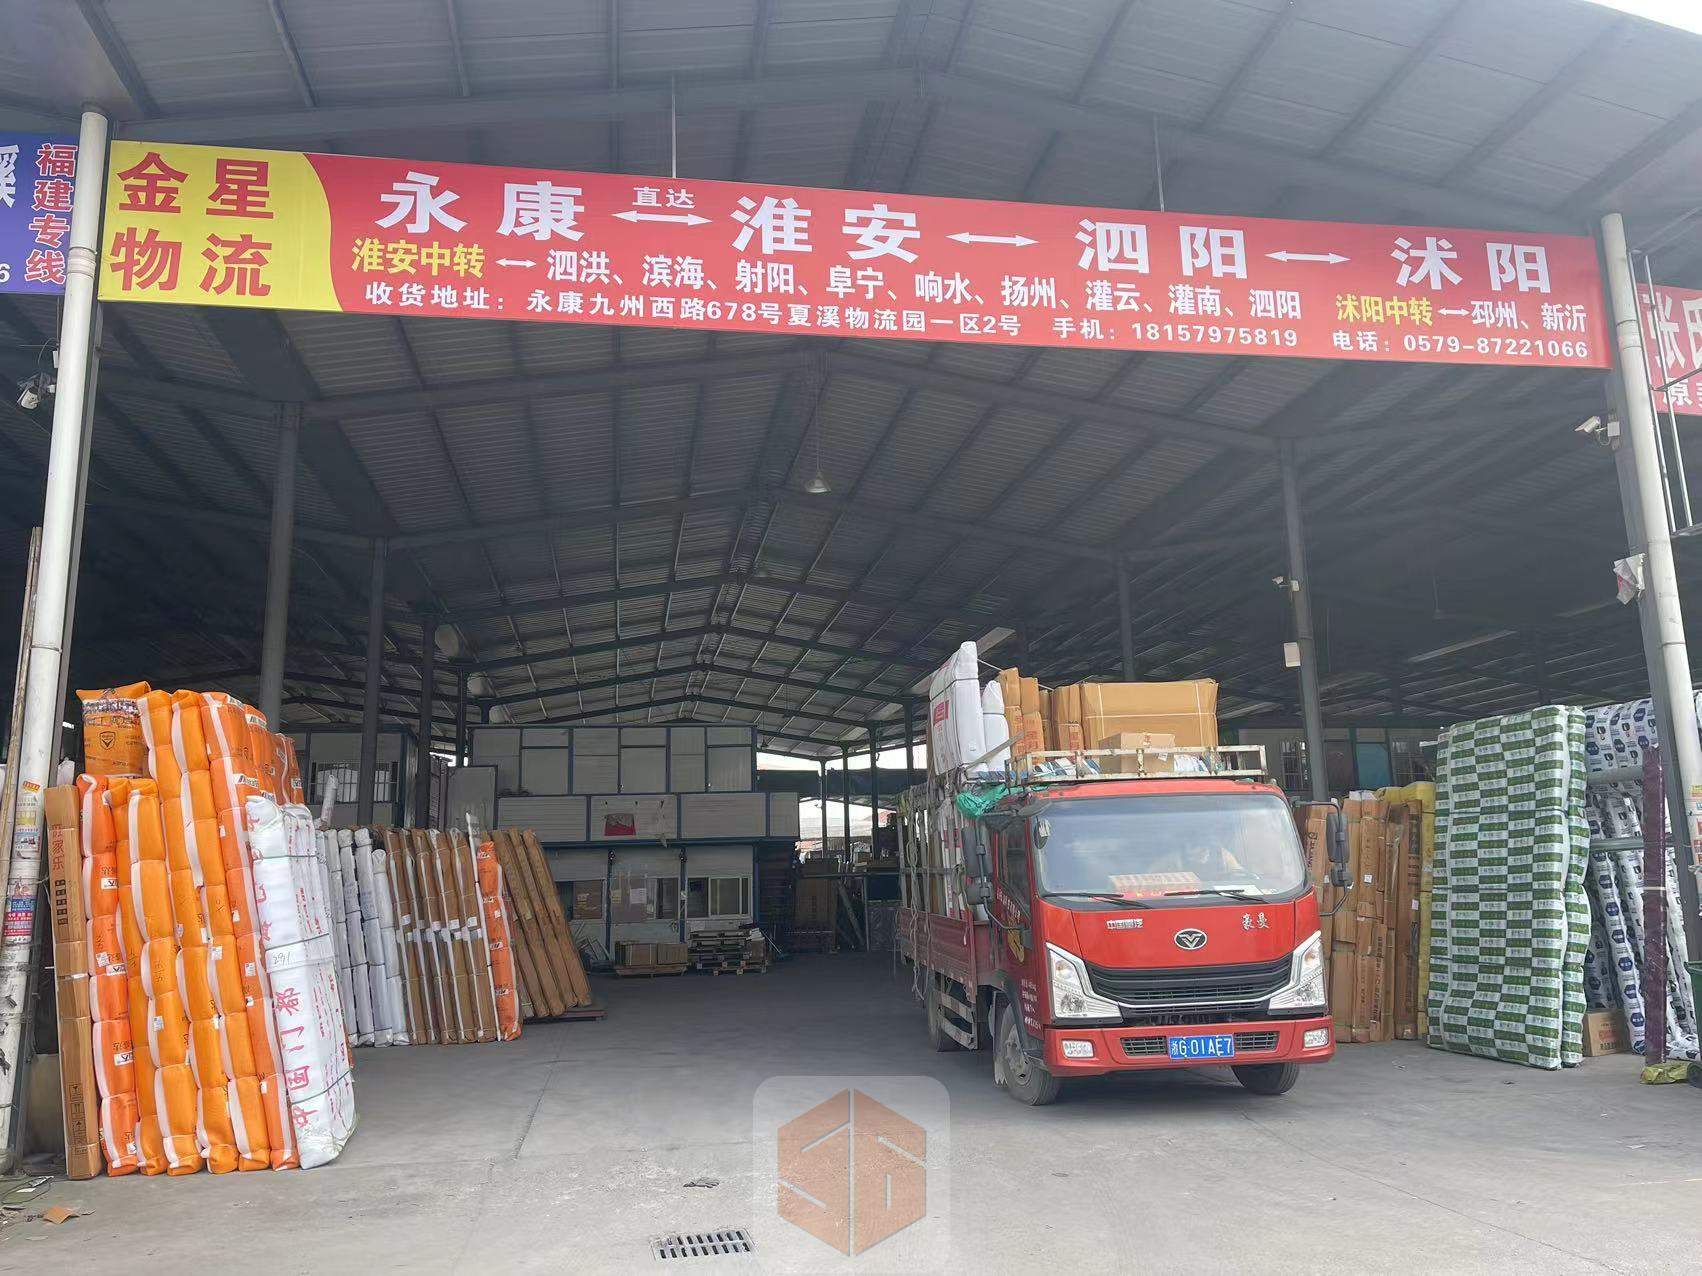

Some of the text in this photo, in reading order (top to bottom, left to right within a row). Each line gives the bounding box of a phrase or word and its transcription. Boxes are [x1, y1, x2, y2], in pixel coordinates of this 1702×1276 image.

[25, 143, 78, 285] 福建专线
[117, 152, 274, 219] 金星
[374, 170, 585, 242] 永康
[632, 186, 696, 209] 直达
[729, 195, 921, 264] 淮安
[1074, 218, 1248, 279] 泗阳
[110, 227, 272, 296] 物流
[350, 238, 486, 279] 淮安中转
[1470, 300, 1587, 333] 邳州、新沂
[526, 289, 1021, 337] 永康九州西路678号夏溪物流园一区2号
[1131, 322, 1298, 347] 18157975819
[1403, 334, 1588, 359] 0579-87221066
